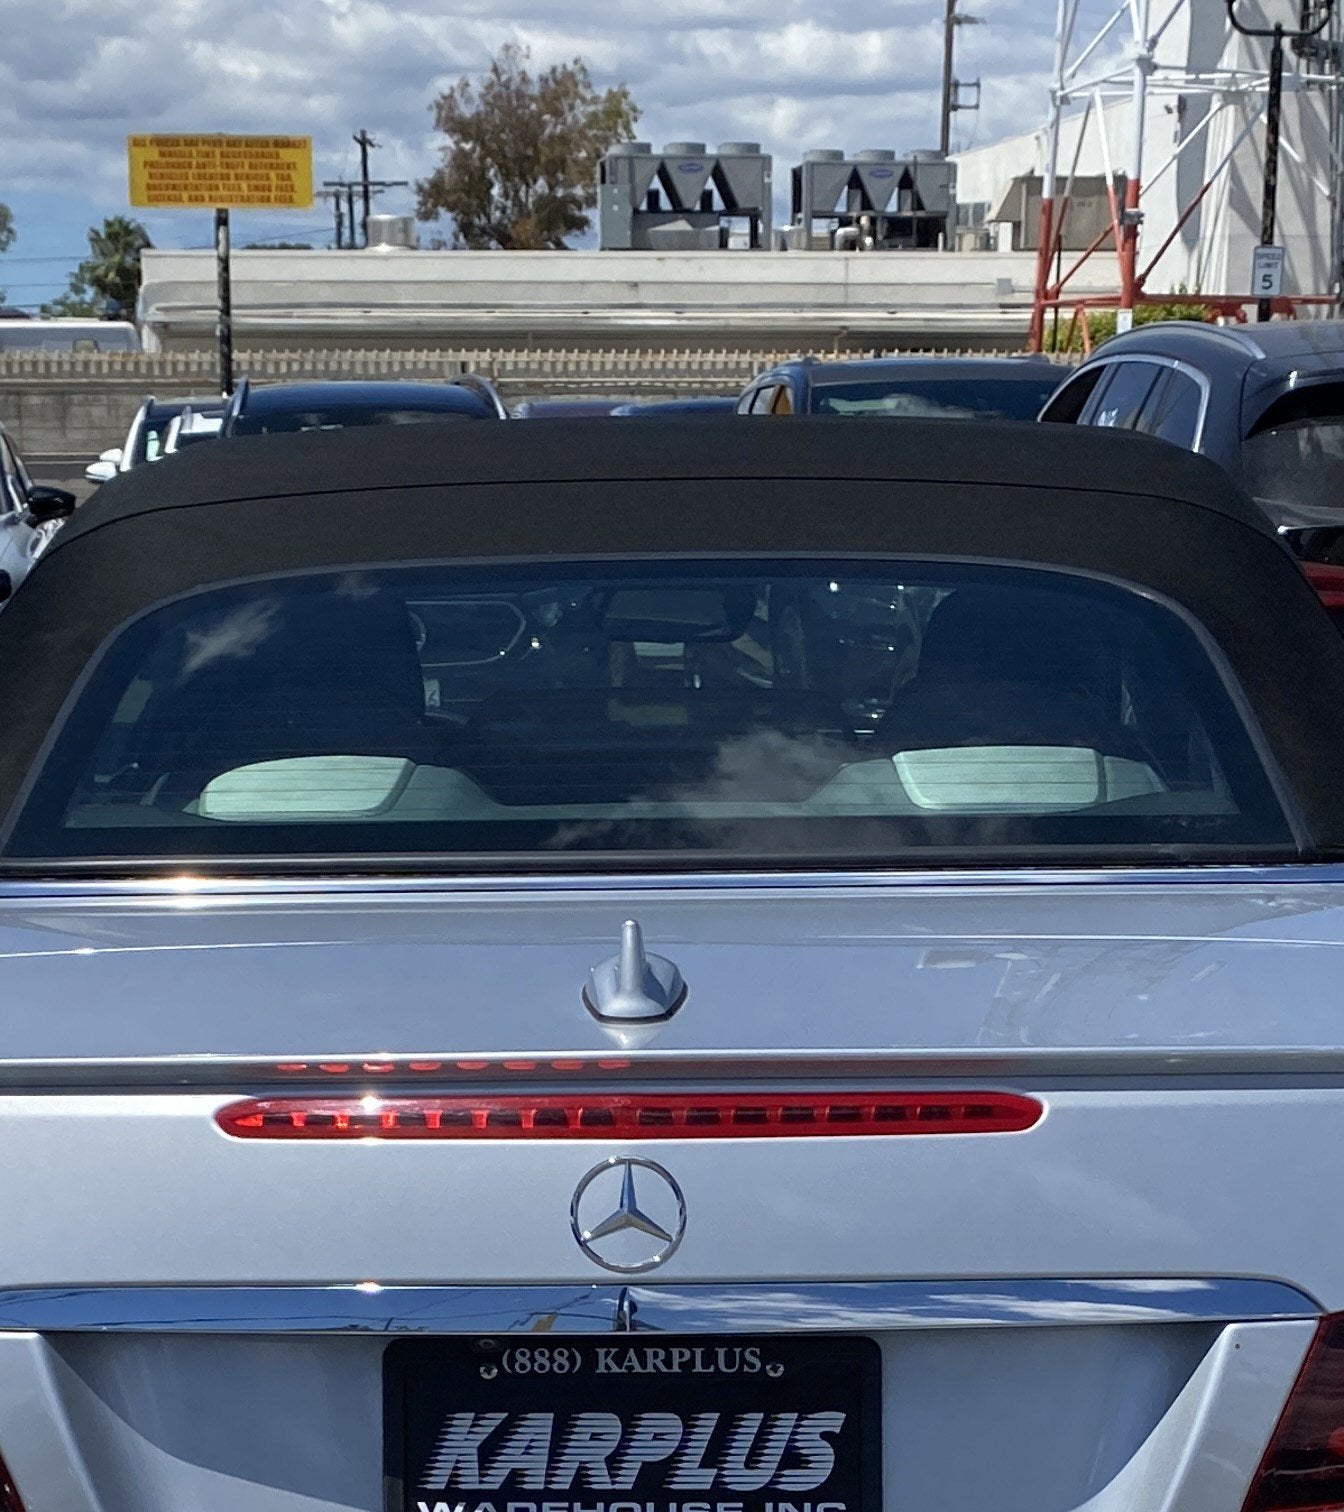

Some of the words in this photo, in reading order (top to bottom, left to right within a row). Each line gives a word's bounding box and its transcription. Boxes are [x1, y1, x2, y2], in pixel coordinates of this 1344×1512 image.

[1261, 274, 1273, 290] 5
[501, 1347, 583, 1375] (888)
[595, 1347, 762, 1375] KARPLUS
[417, 1411, 847, 1491] KARPLUS
